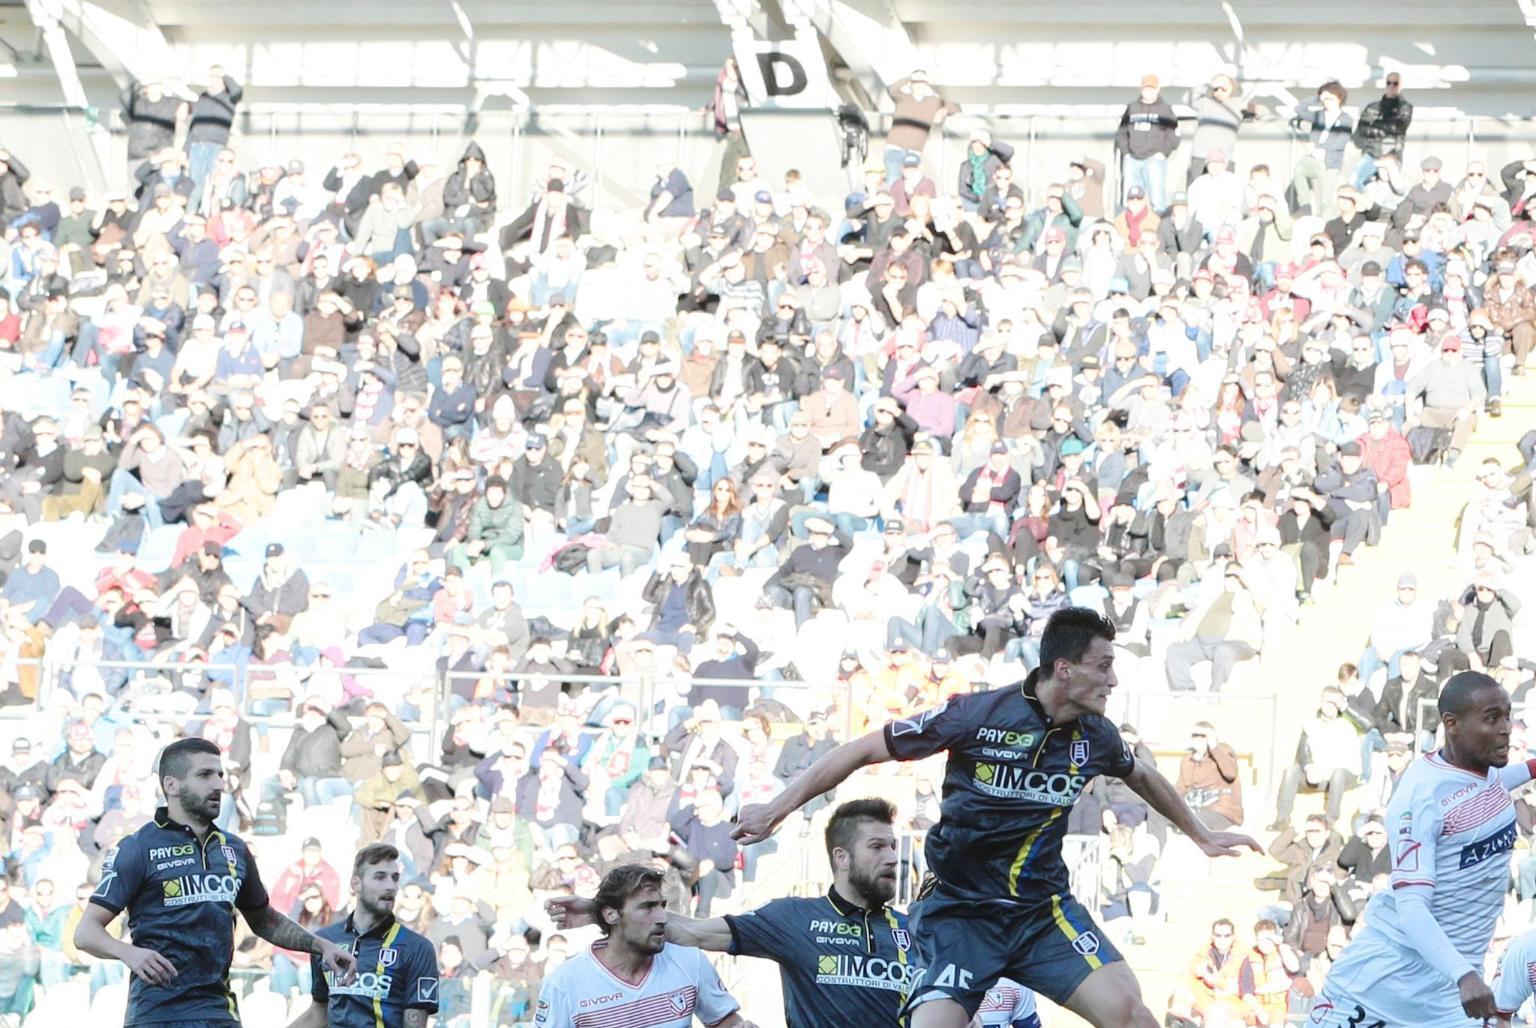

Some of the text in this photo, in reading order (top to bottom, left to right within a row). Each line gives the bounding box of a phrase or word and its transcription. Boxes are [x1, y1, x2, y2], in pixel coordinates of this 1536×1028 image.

[756, 52, 808, 96] D
[1441, 782, 1478, 806] GIVOVA
[157, 858, 196, 871] GIVOVA
[816, 936, 860, 946] GIVOVA
[580, 992, 624, 1007] GIVOVA
